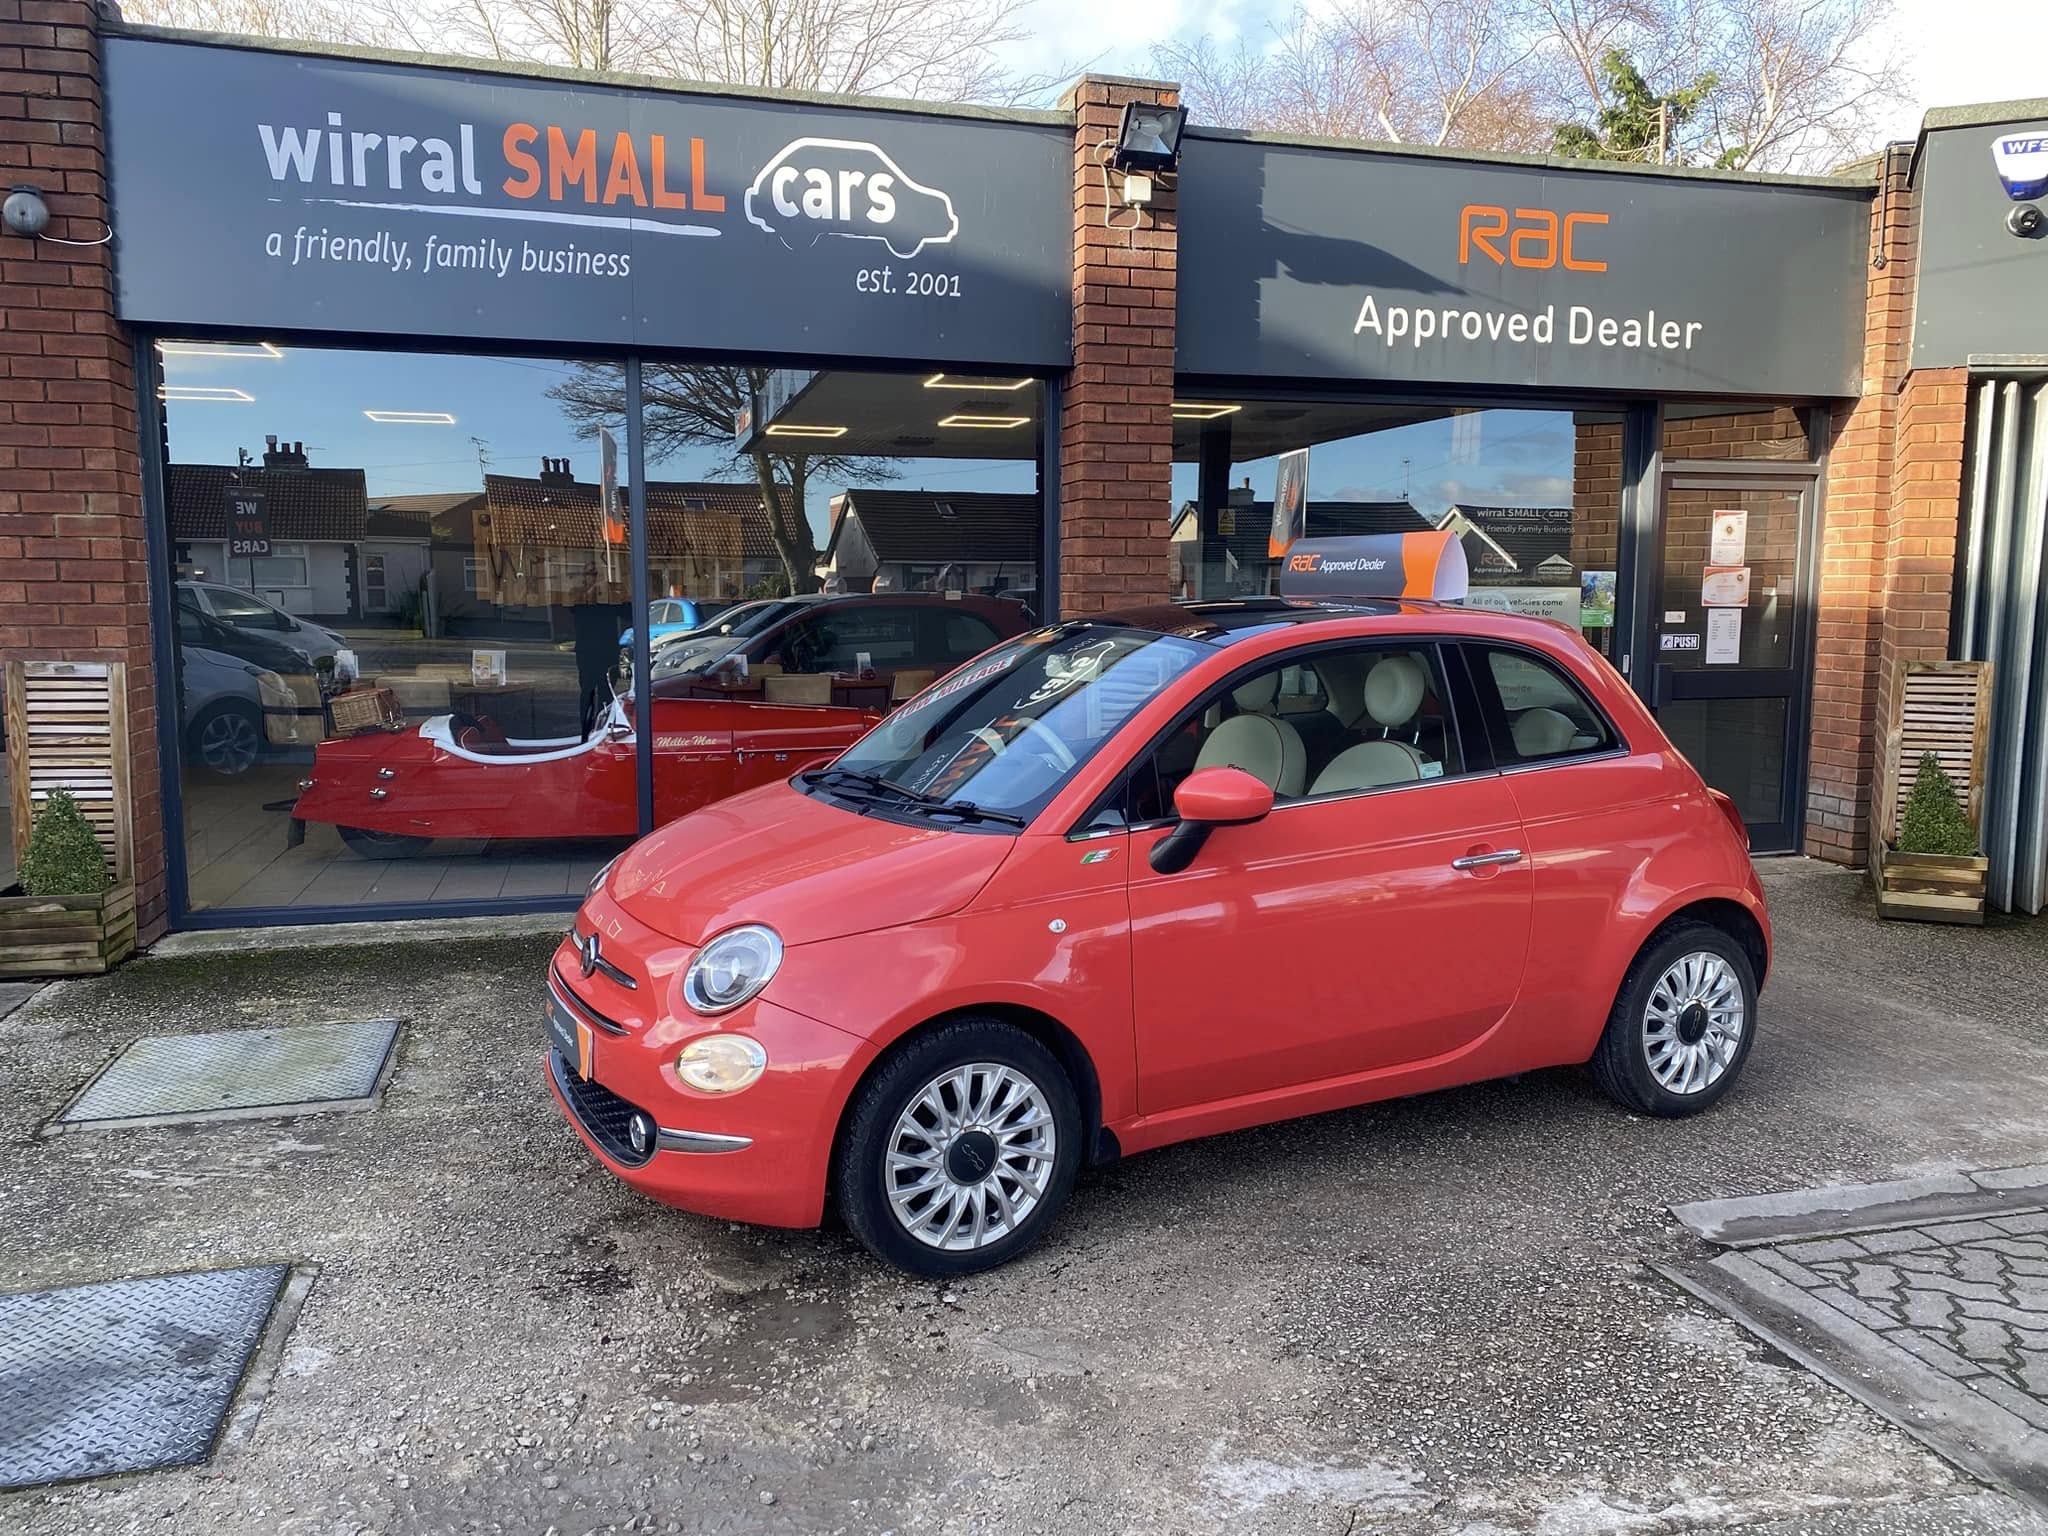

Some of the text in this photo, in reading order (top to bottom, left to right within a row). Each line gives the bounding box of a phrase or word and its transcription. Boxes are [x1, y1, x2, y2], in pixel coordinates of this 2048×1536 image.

[258, 111, 897, 224] wirral SMALL cars
[265, 226, 631, 278] a friendly, family business
[856, 264, 962, 297] est. 2001
[1353, 295, 1703, 350] Approved Dealer
[1477, 509, 1569, 518] wirral SMALL cars
[1487, 524, 1517, 534] Friendly
[1518, 525, 1543, 534] Family
[1544, 525, 1576, 533] Business
[1320, 559, 1358, 573] Approved
[1358, 558, 1386, 570] Dealer
[1472, 598, 1482, 606] All
[1484, 598, 1493, 606] of
[1510, 598, 1540, 606] vehicles
[1673, 636, 1697, 648] PUSH
[656, 736, 690, 748] Millie
